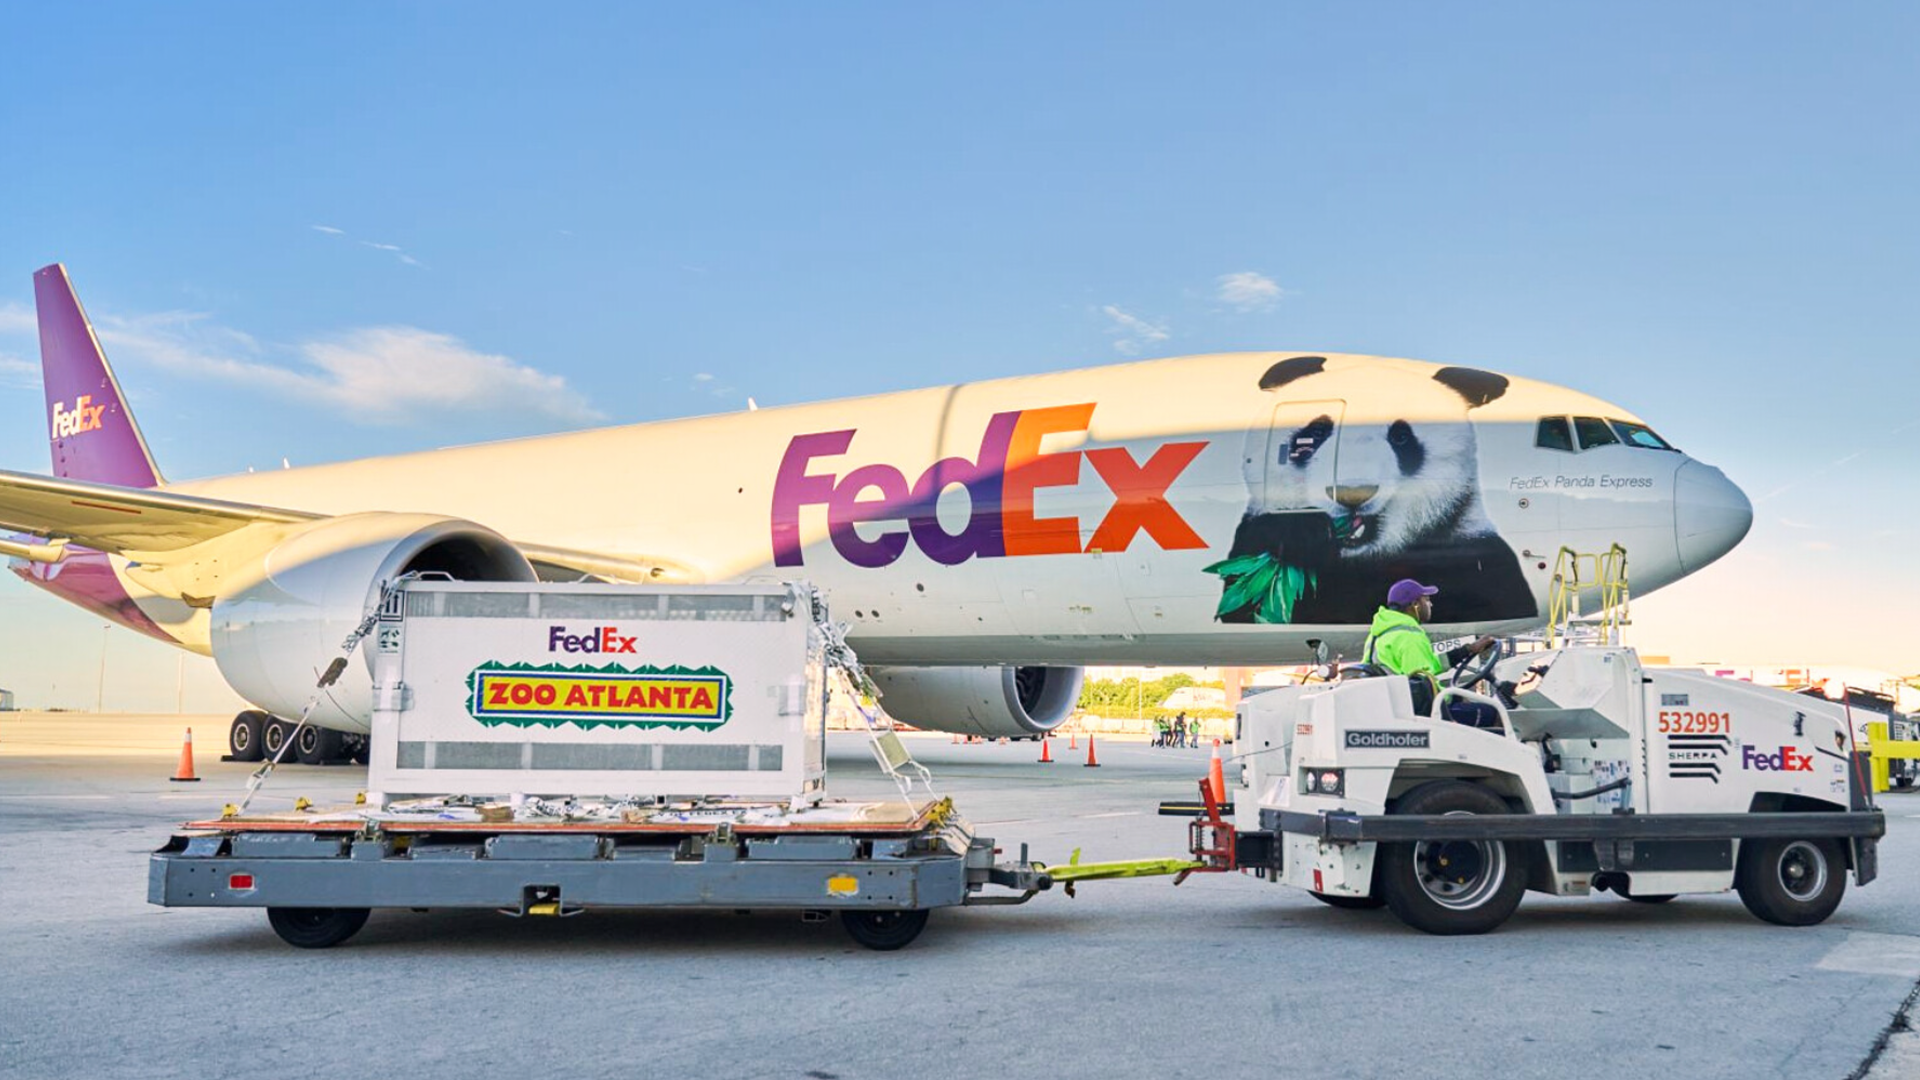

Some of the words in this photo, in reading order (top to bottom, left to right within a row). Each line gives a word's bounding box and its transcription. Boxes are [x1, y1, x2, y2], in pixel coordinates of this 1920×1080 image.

[52, 395, 106, 440] FedEx
[770, 402, 1211, 569] FedEx
[1509, 476, 1549, 489] FedEx
[1554, 475, 1595, 487] Panda
[1600, 474, 1653, 489] Express
[548, 626, 638, 654] FedEx
[489, 682, 556, 705] ZOO
[564, 684, 714, 709] ATLANTA
[1658, 711, 1730, 733] 532991
[1347, 733, 1427, 746] Goldhofer
[1669, 752, 1718, 760] SHERPA
[1742, 745, 1814, 772] FedEx
